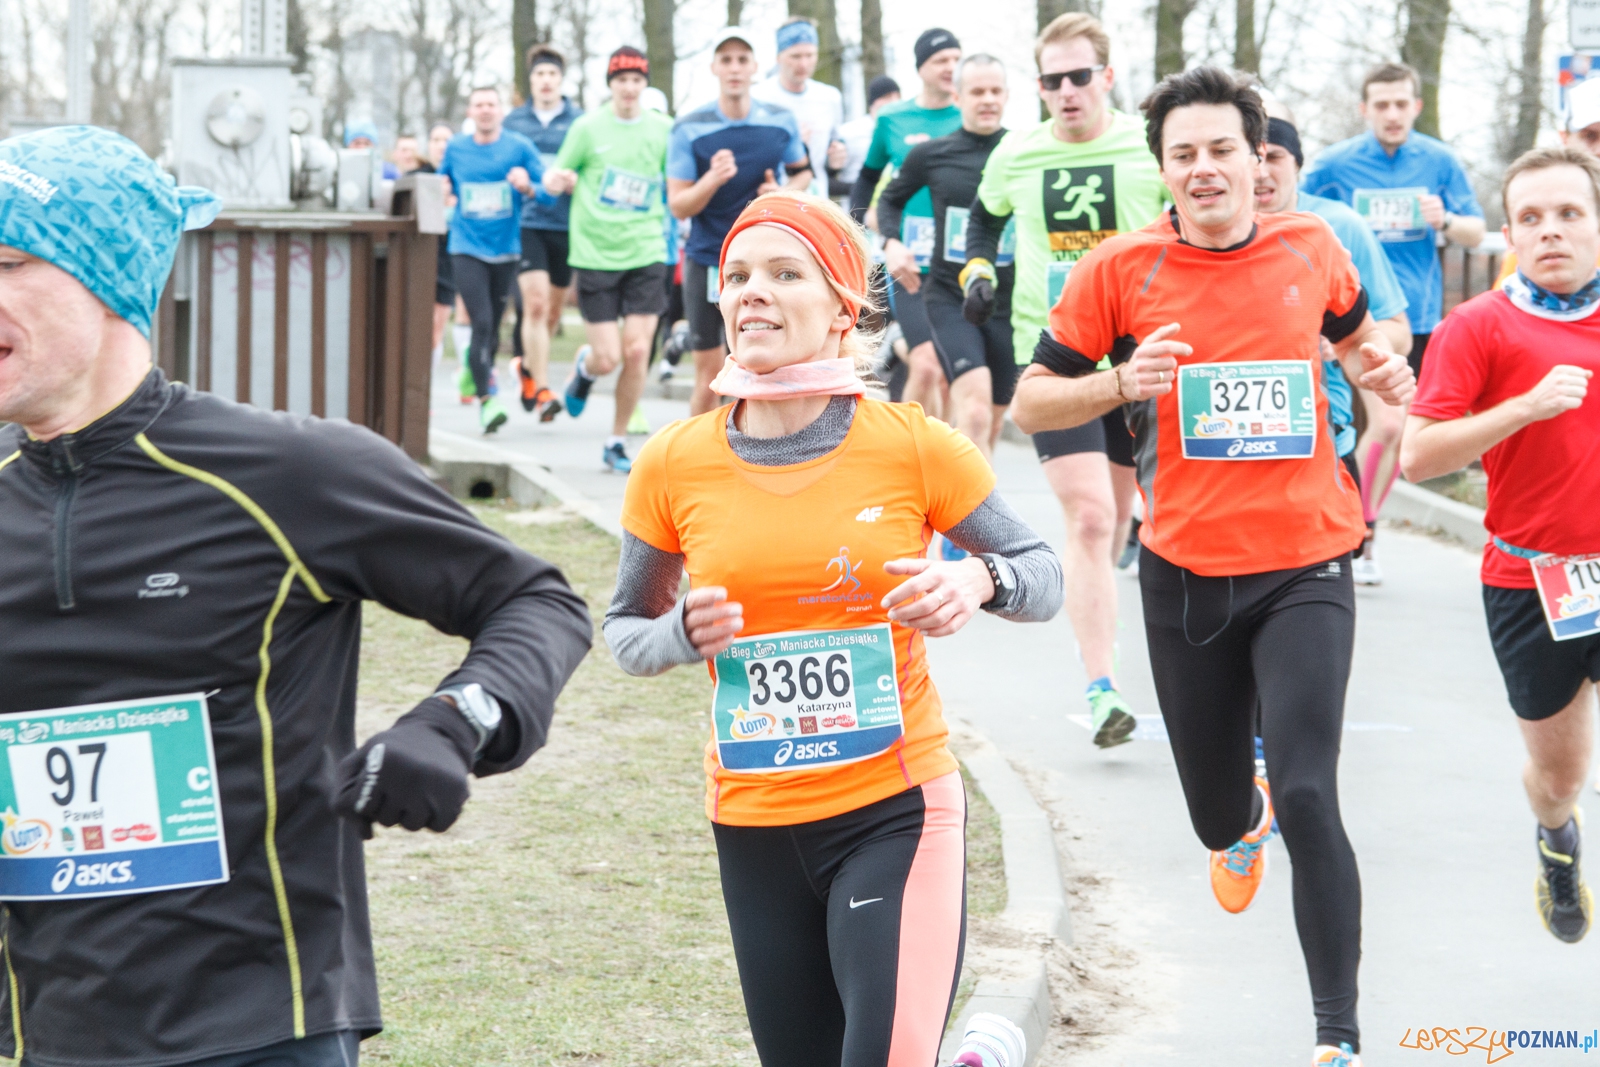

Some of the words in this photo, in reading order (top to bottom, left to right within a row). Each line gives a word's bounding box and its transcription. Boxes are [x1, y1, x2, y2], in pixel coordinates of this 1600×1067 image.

[1374, 198, 1410, 217] 1739
[1214, 380, 1286, 412] 3276
[855, 506, 884, 522] 4F
[731, 647, 750, 659] Bieg
[780, 636, 826, 652] Maniacka
[828, 633, 878, 647] Dziesiątka
[749, 653, 850, 705] 3366
[877, 674, 892, 691] C
[797, 700, 852, 714] Katarzyna
[872, 695, 896, 704] strefa
[862, 705, 897, 715] startowa
[869, 713, 898, 724] zielona
[52, 715, 116, 736] Maniacka
[117, 707, 189, 728] Dziesiątka
[739, 716, 768, 734] LOTTO
[46, 743, 107, 806] 97
[187, 766, 211, 791] C
